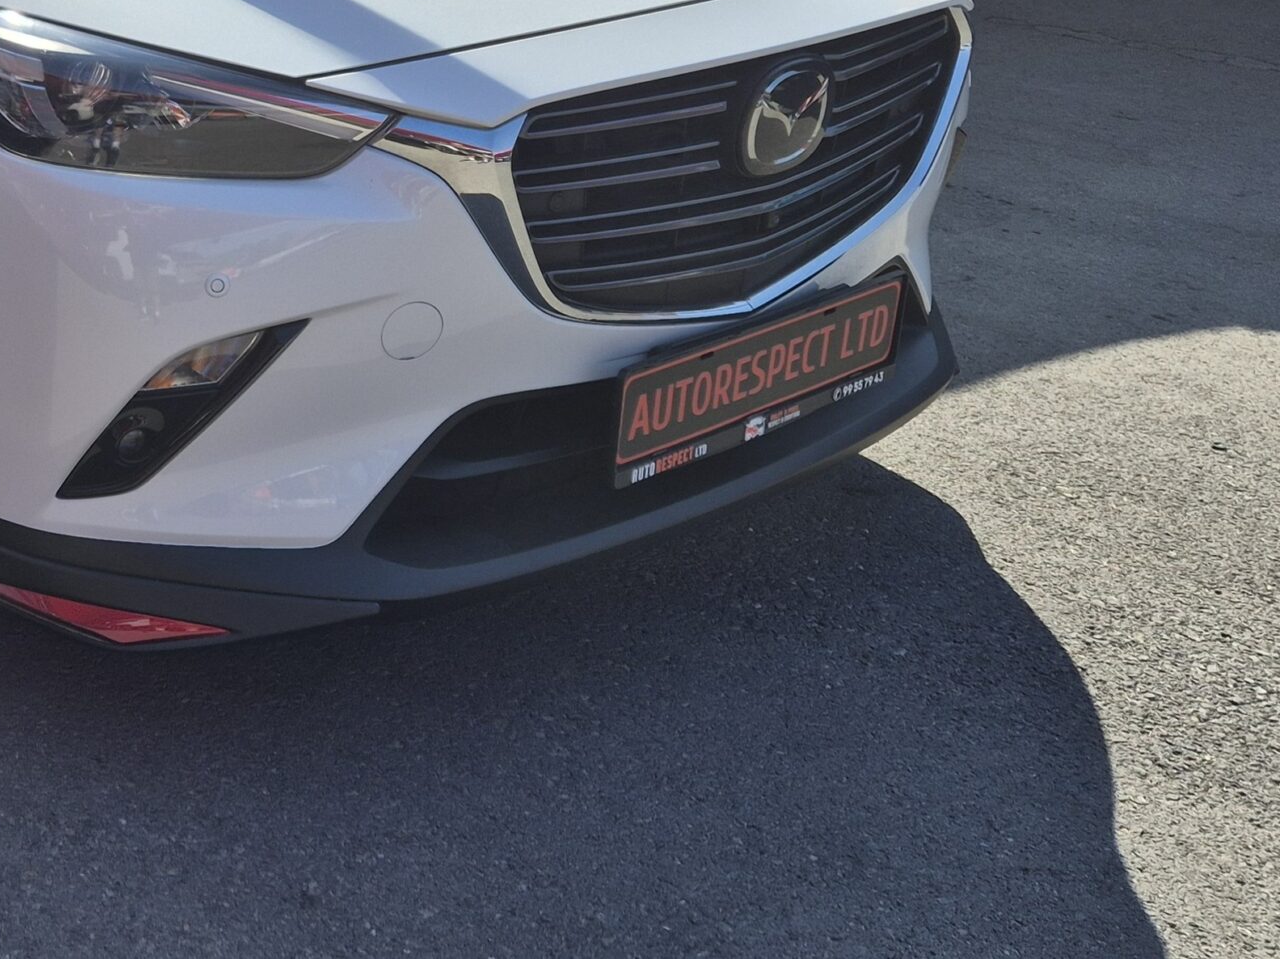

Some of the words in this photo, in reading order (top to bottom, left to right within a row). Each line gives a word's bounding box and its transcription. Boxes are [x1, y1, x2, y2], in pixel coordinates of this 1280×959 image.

[627, 324, 836, 441] AUTORESPECT
[839, 305, 889, 359] LTD
[694, 443, 708, 458] LTD
